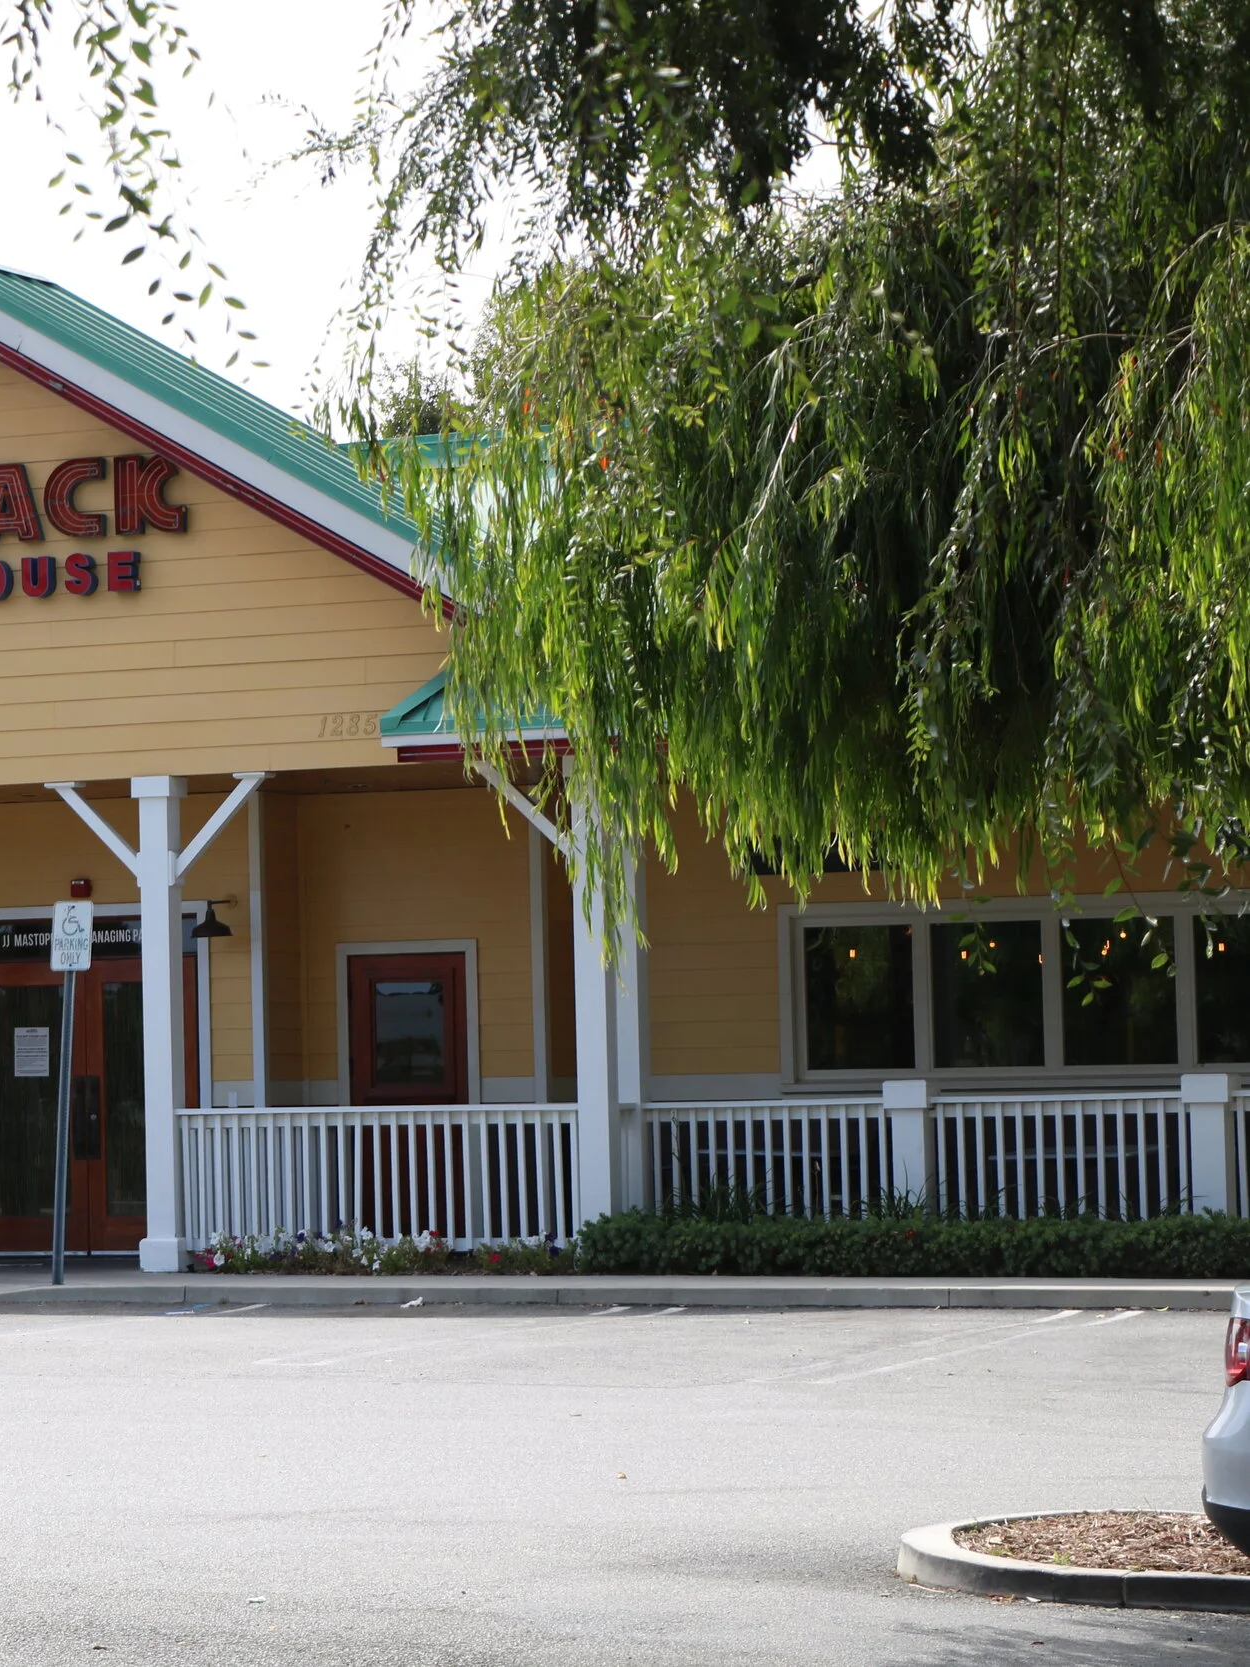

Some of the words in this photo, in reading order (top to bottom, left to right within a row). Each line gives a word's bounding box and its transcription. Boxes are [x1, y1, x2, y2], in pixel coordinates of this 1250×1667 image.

[317, 713, 379, 738] 1285
[2, 935, 10, 948] JJ
[91, 929, 131, 943] ANAGING
[54, 938, 89, 951] PARKING
[60, 951, 81, 965] ONLY
